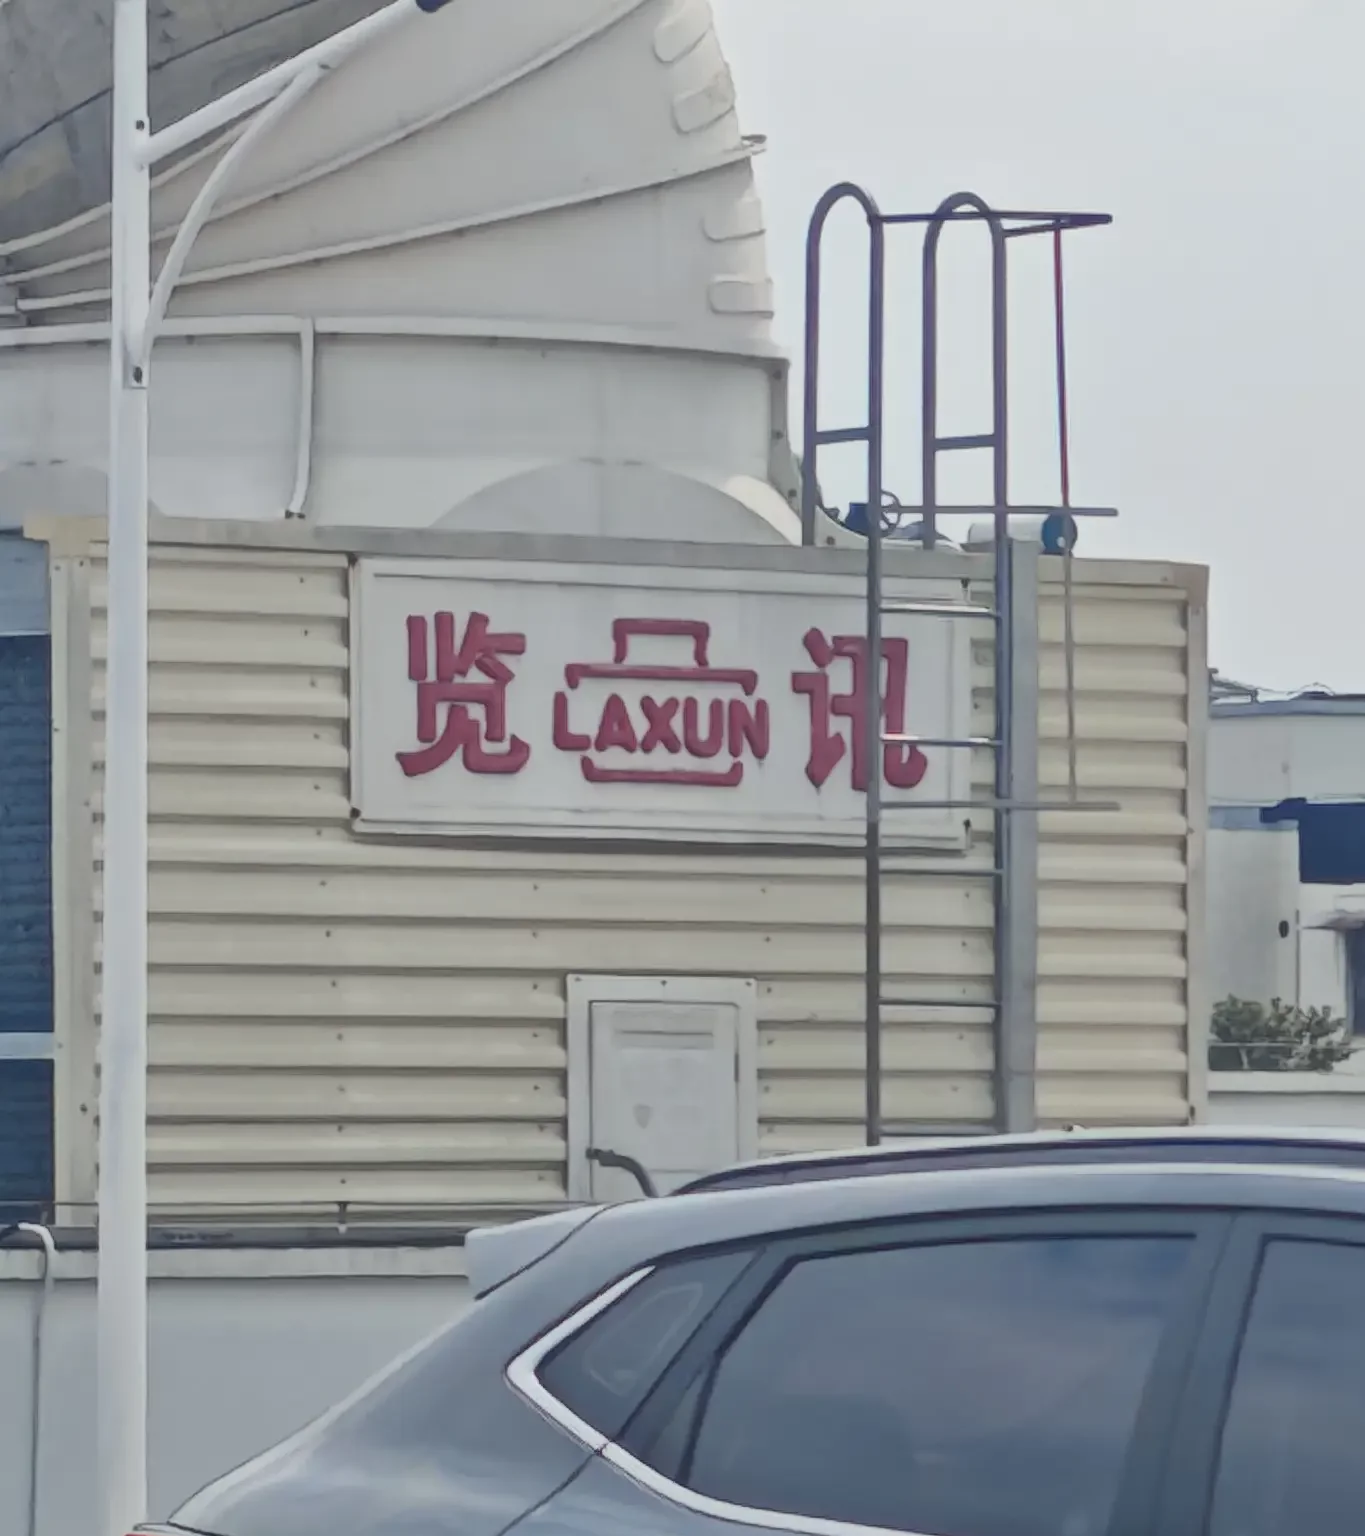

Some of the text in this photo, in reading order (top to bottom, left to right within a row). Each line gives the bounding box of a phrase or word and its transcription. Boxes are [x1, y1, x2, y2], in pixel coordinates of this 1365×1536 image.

[396, 612, 530, 776] 览
[552, 691, 769, 760] LAXUN
[791, 627, 928, 792] 讯
